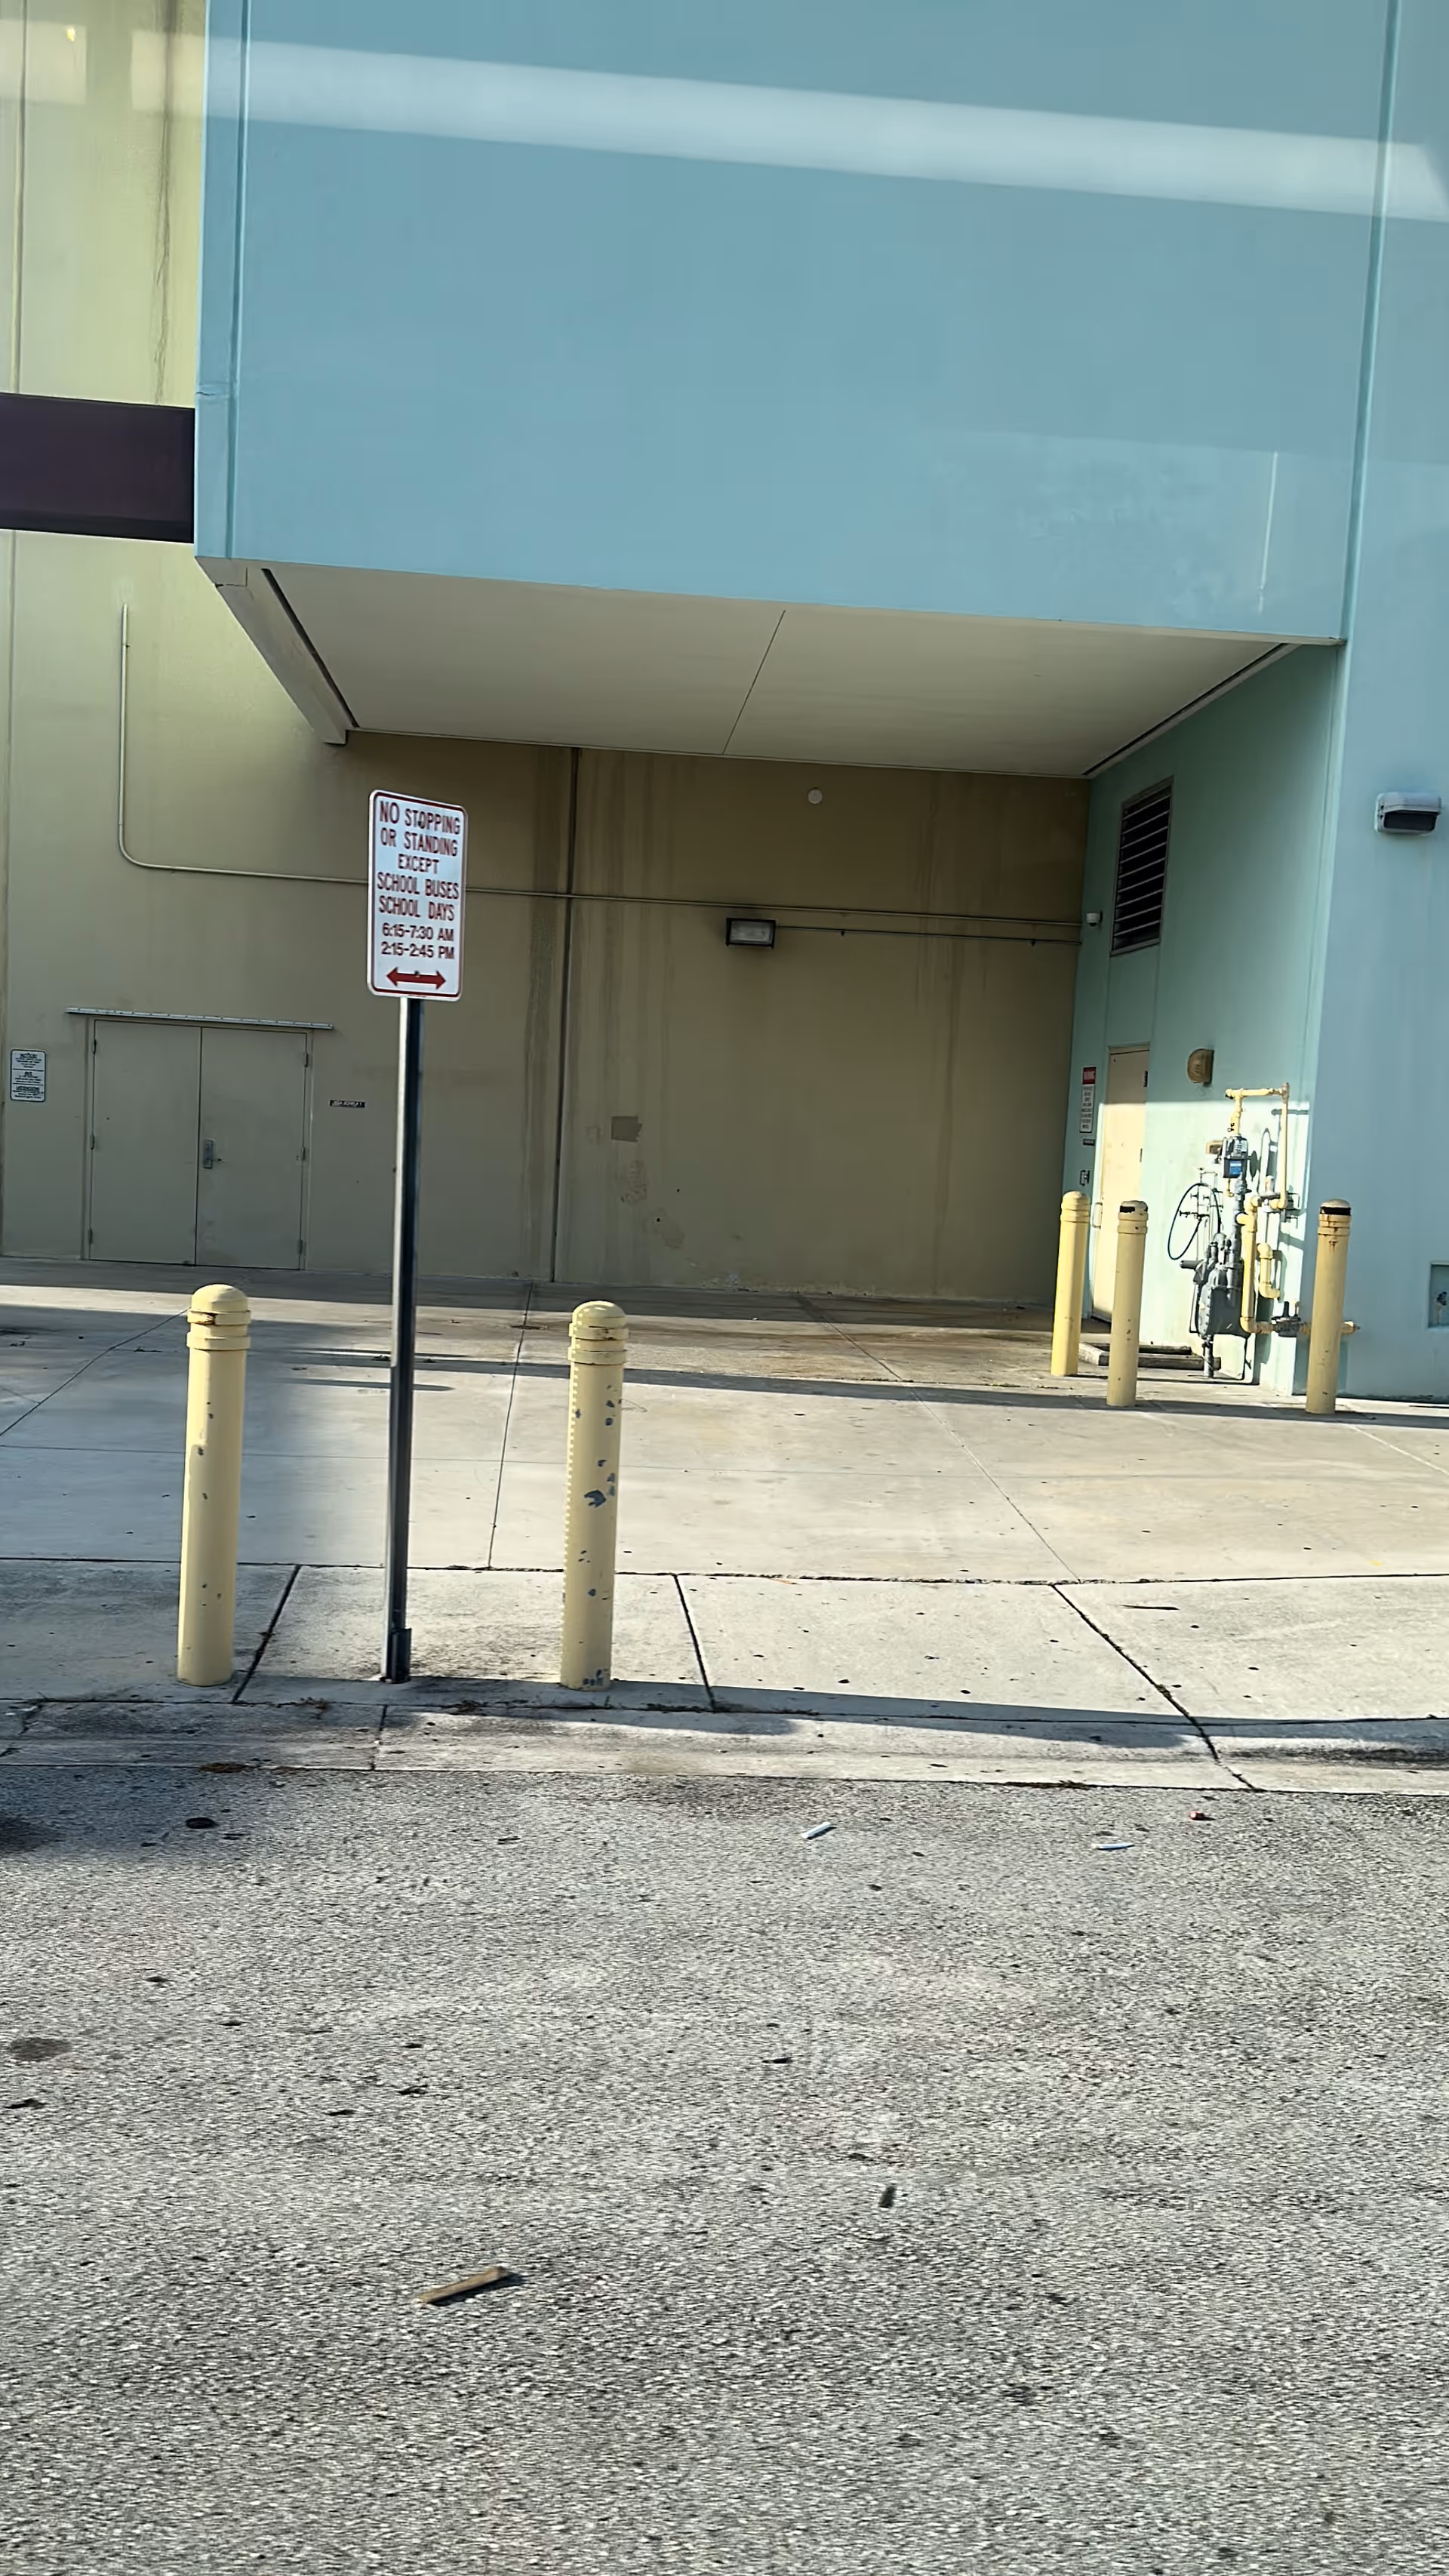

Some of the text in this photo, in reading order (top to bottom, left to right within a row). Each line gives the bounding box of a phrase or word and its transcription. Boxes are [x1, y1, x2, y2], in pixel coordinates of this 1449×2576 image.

[380, 801, 460, 835] NO STOPPING
[380, 827, 458, 857] OR STANDING
[398, 854, 440, 875] EXCEPT
[377, 872, 460, 900] SCHOOL BUSES
[379, 895, 455, 921] SCHOOL DAYS
[382, 922, 454, 941] 6:15-7:30 AM
[381, 941, 454, 959] 2:15-2:45 PM
